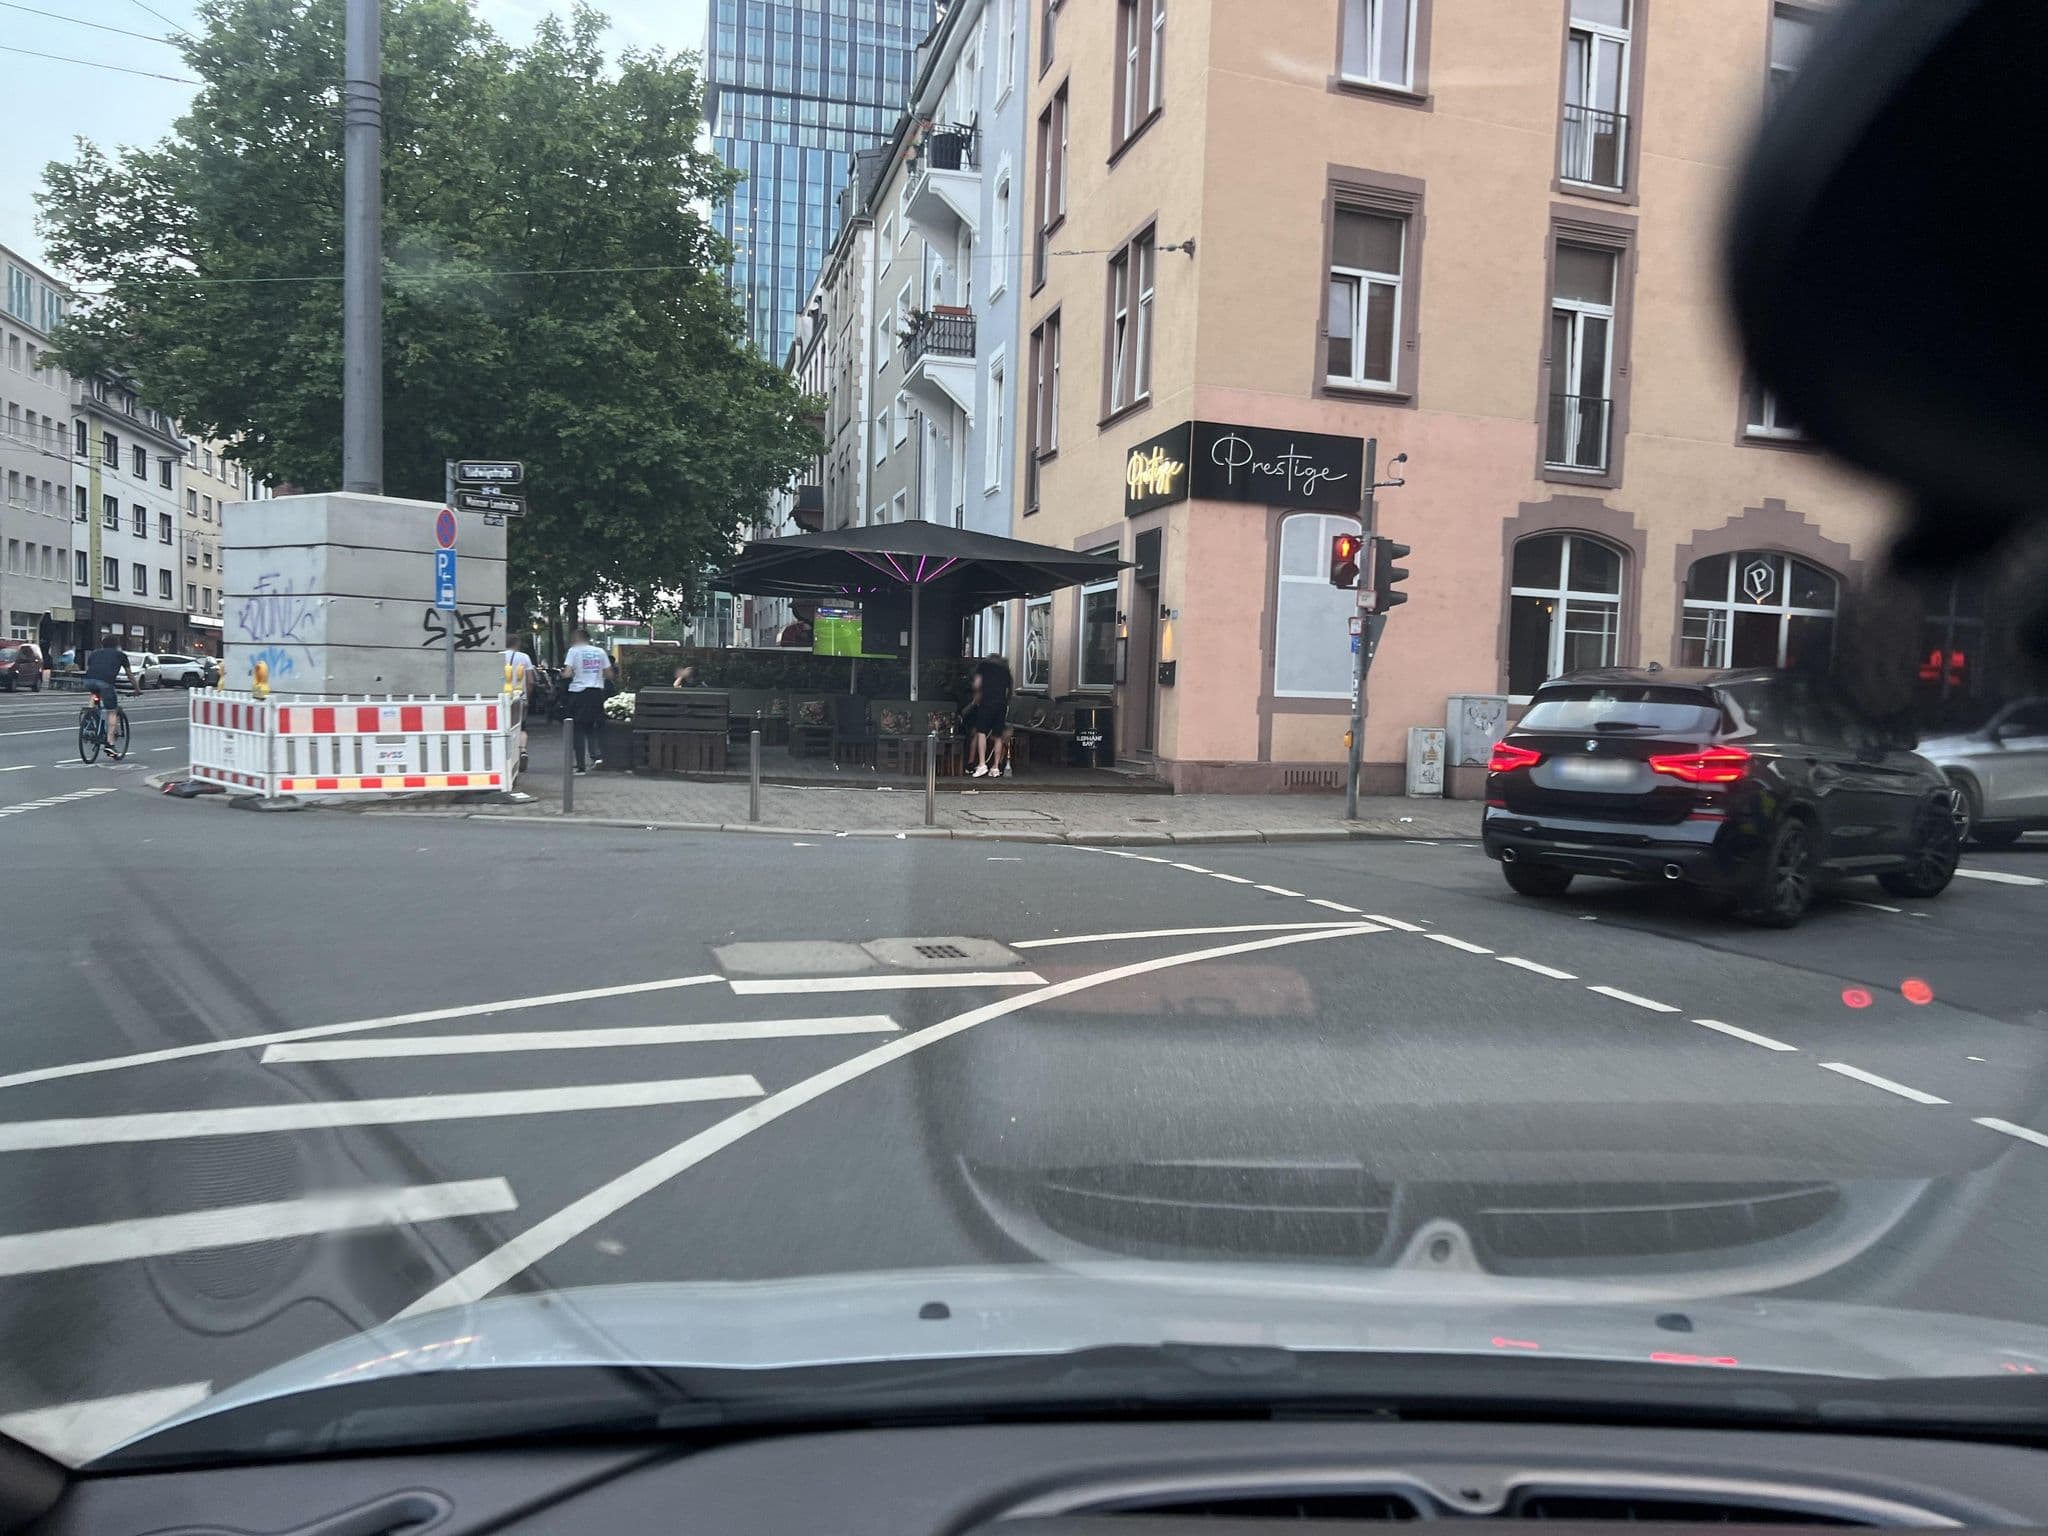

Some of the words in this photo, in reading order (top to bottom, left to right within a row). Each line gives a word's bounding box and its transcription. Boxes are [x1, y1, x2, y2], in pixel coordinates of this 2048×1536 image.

[1211, 432, 1348, 495] Prestige
[438, 553, 449, 577] P
[1750, 568, 1767, 594] P
